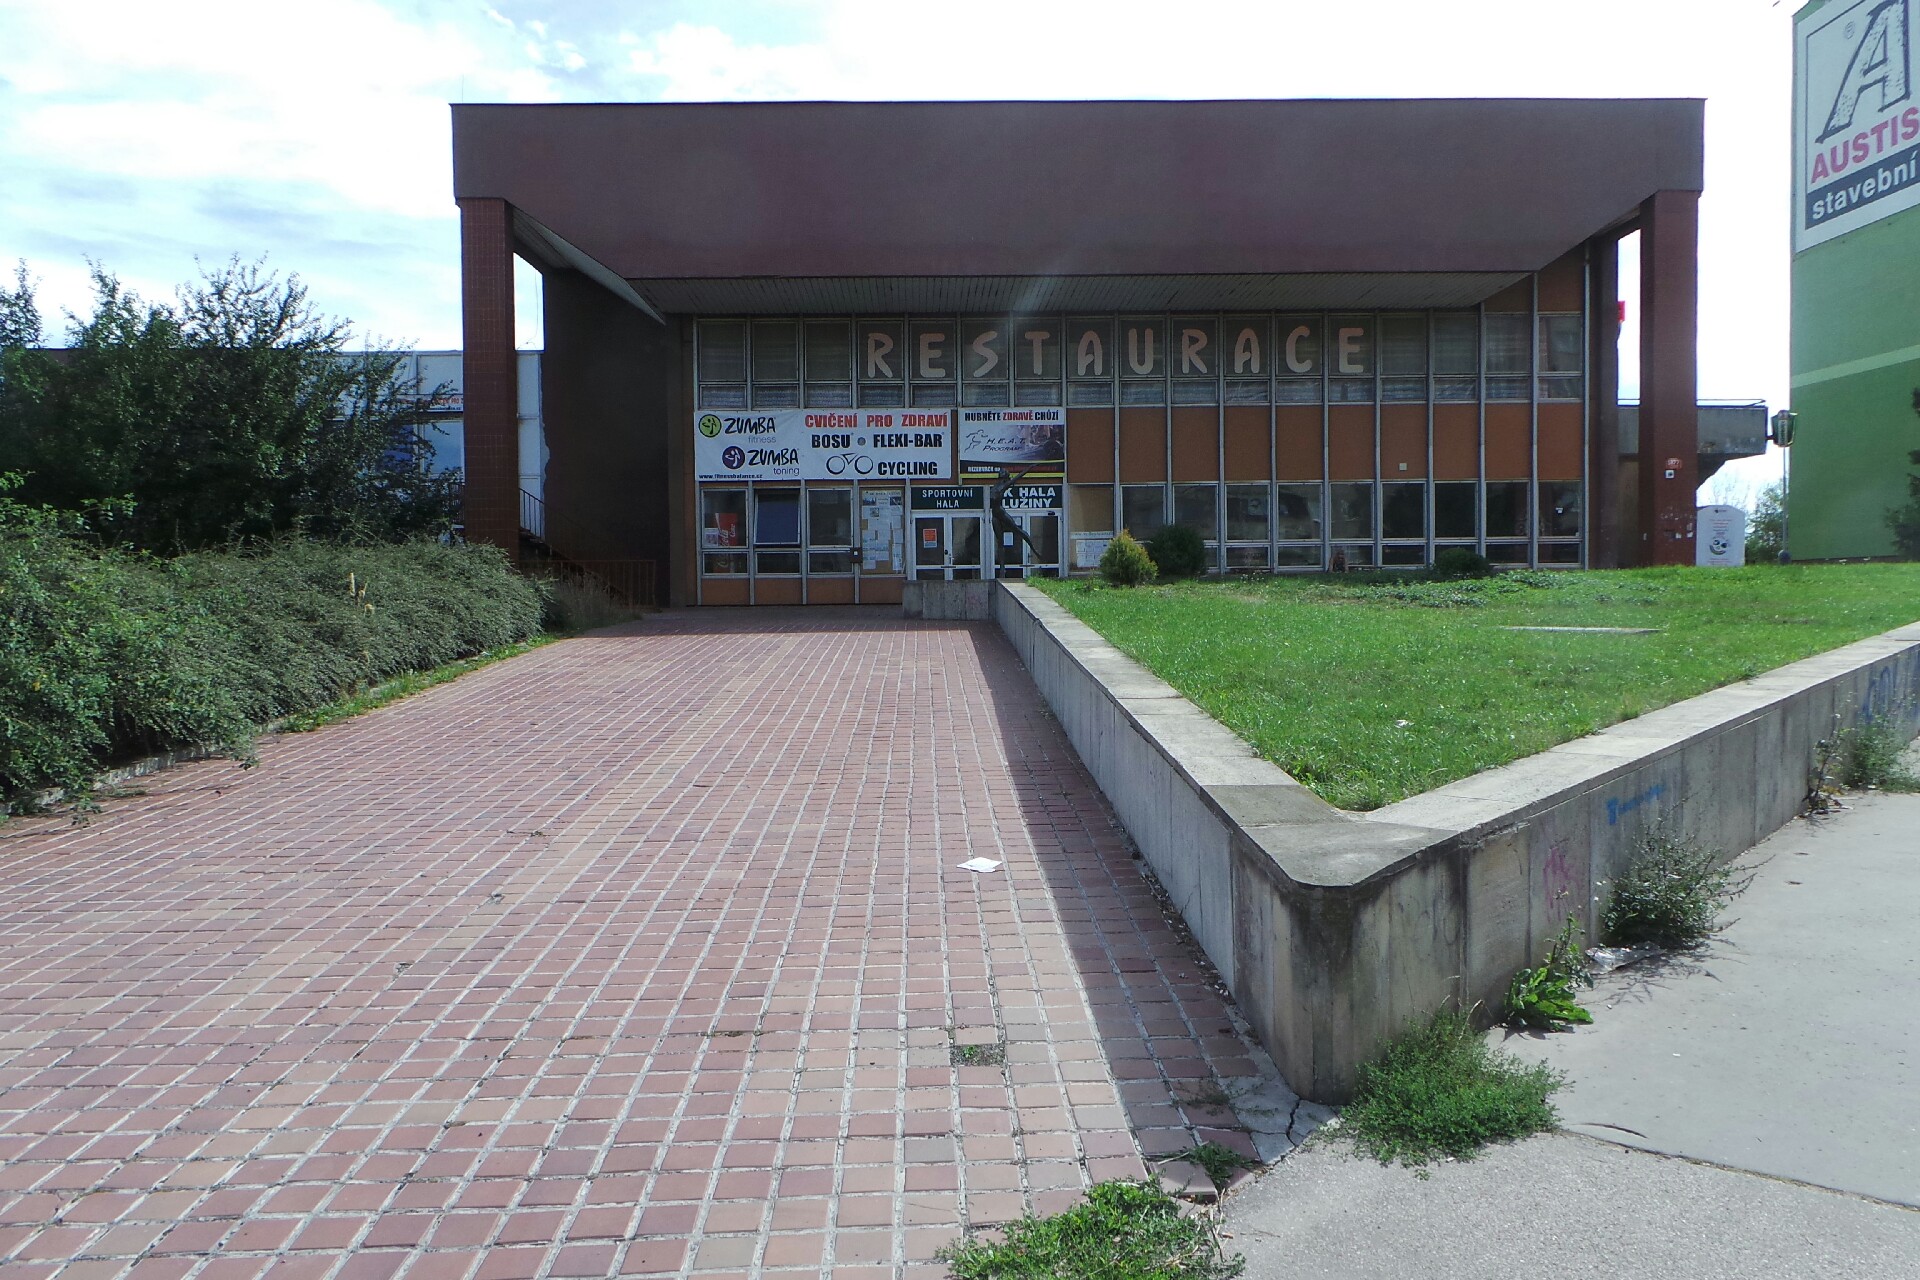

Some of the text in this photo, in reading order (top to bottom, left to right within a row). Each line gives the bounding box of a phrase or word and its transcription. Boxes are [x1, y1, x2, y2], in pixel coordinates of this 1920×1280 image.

[1810, 106, 1920, 184] AUSTIS
[1812, 150, 1918, 220] stavební
[867, 326, 1365, 378] RESTAURACE
[804, 412, 948, 428] CVIČENÍ PRO ZDRAVÍ
[964, 410, 1001, 422] HUBNĚTE
[1034, 409, 1059, 421] CHŮZÍ
[724, 417, 776, 434] ZUMBA
[748, 435, 777, 444] fitness
[811, 433, 943, 448] BOSU FLEXI-BAR
[747, 448, 799, 466] ZUMBA
[773, 467, 800, 476] toning
[877, 461, 938, 475] CYCLING
[922, 488, 973, 498] SPORTOVNÍ
[1019, 487, 1056, 497] HALA
[936, 500, 960, 508] HALA
[1001, 496, 1053, 509] LUŽINY
